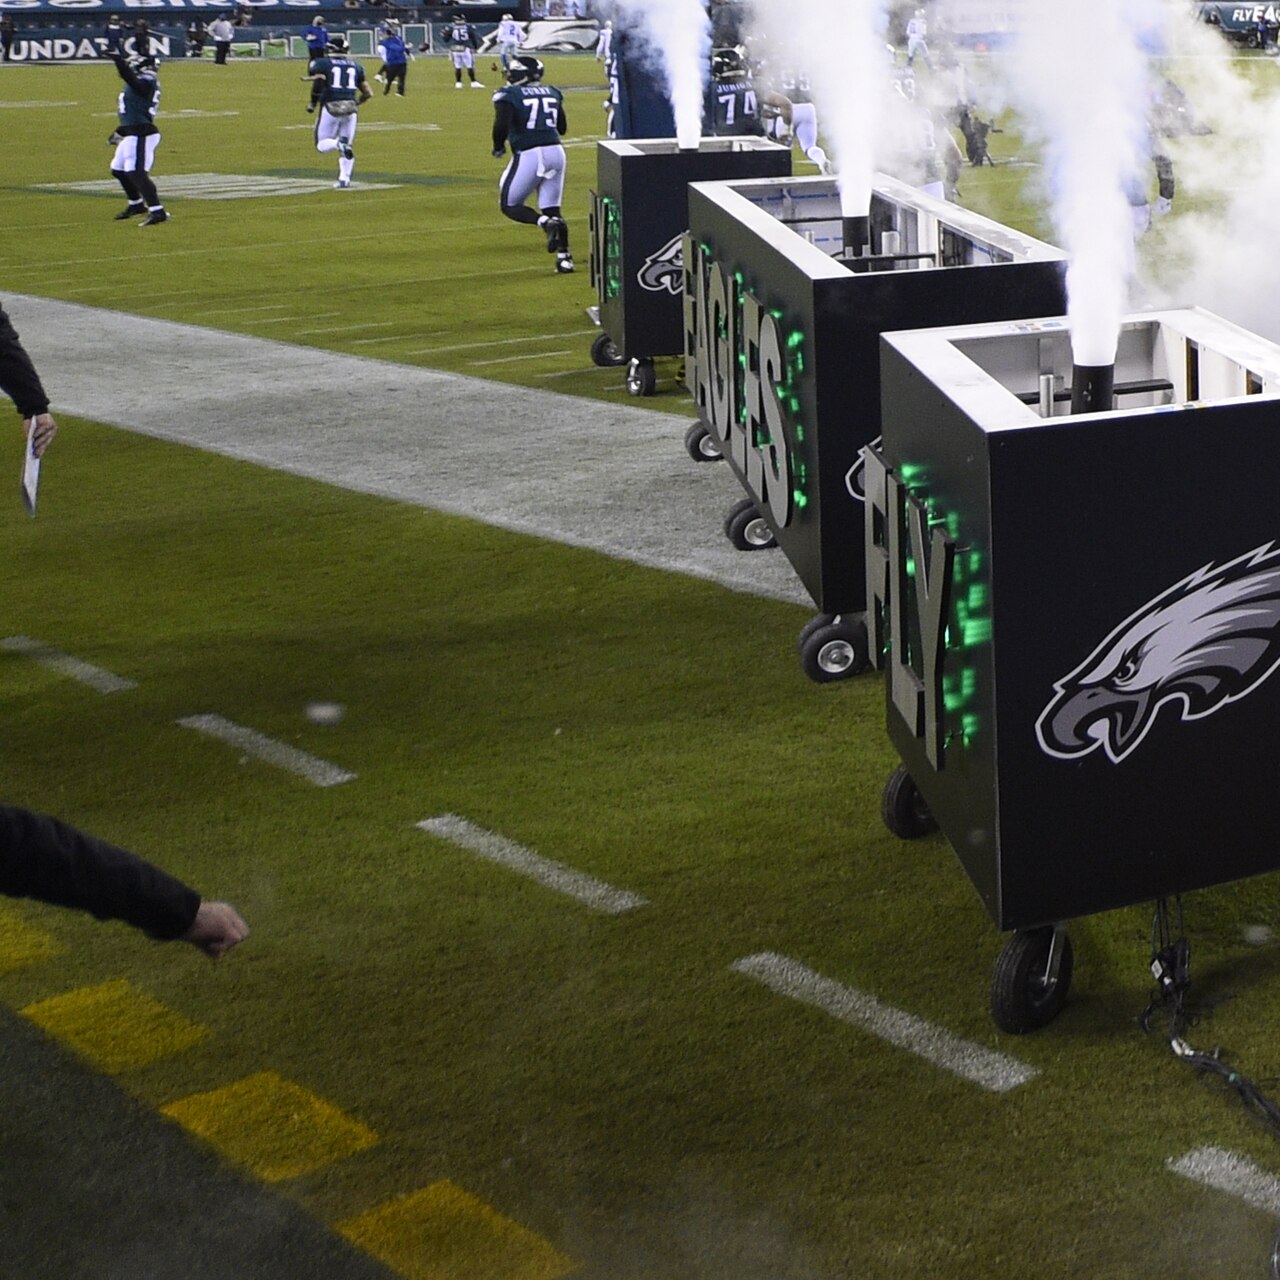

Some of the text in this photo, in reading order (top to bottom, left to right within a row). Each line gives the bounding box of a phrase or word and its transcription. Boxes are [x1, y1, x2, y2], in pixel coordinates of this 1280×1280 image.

[8, 36, 171, 61] UNDATON
[331, 67, 356, 89] 11
[522, 97, 558, 130] 75
